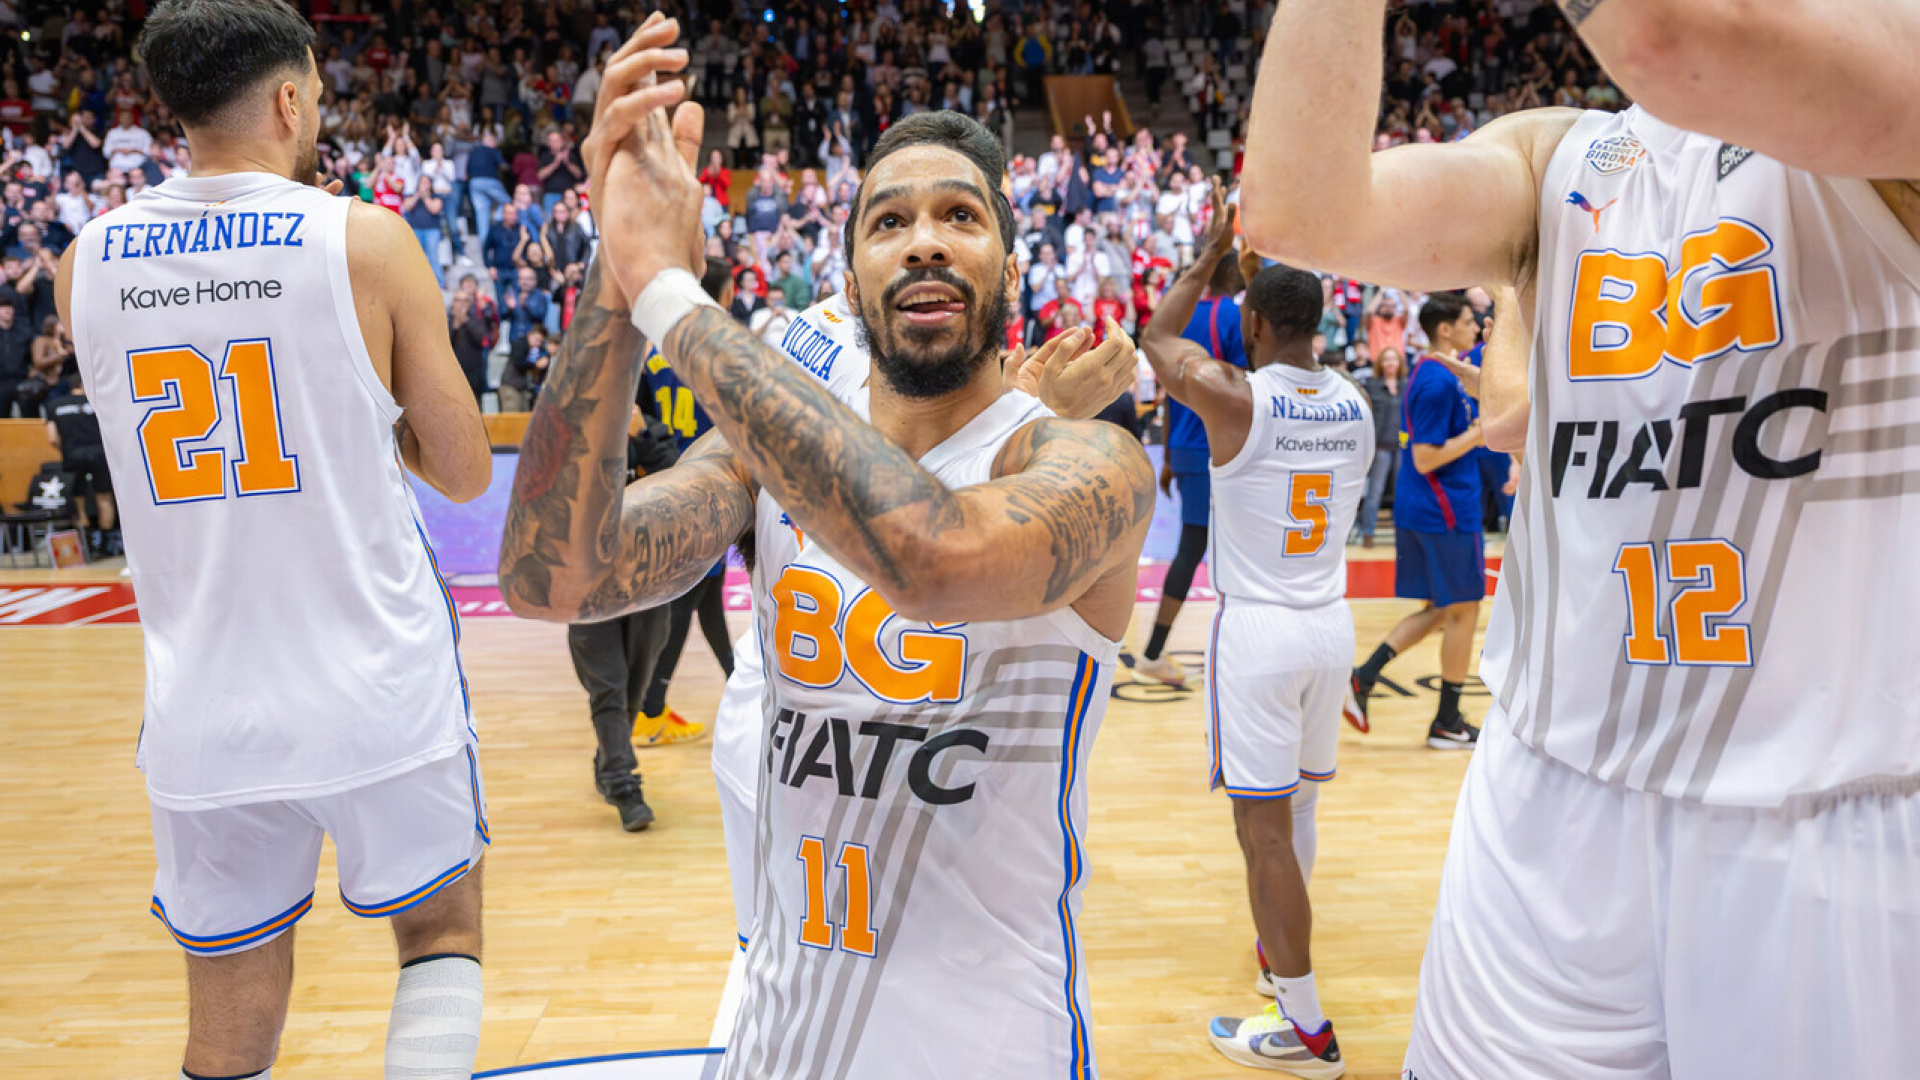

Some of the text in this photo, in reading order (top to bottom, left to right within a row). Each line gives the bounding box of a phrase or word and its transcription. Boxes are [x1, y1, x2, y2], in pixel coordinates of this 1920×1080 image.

[1586, 149, 1636, 167] GIRONA
[102, 211, 305, 262] FERNÁNDEZ
[120, 279, 282, 311] Kave Home
[1566, 217, 1783, 382] BG
[127, 338, 302, 506] 21
[655, 386, 698, 437] 14
[1275, 436, 1357, 452] Kave Home
[1551, 388, 1828, 499] FIATC
[1281, 470, 1334, 558] 5
[769, 563, 969, 705] BG
[1612, 537, 1754, 667] 12
[797, 835, 879, 958] 11
